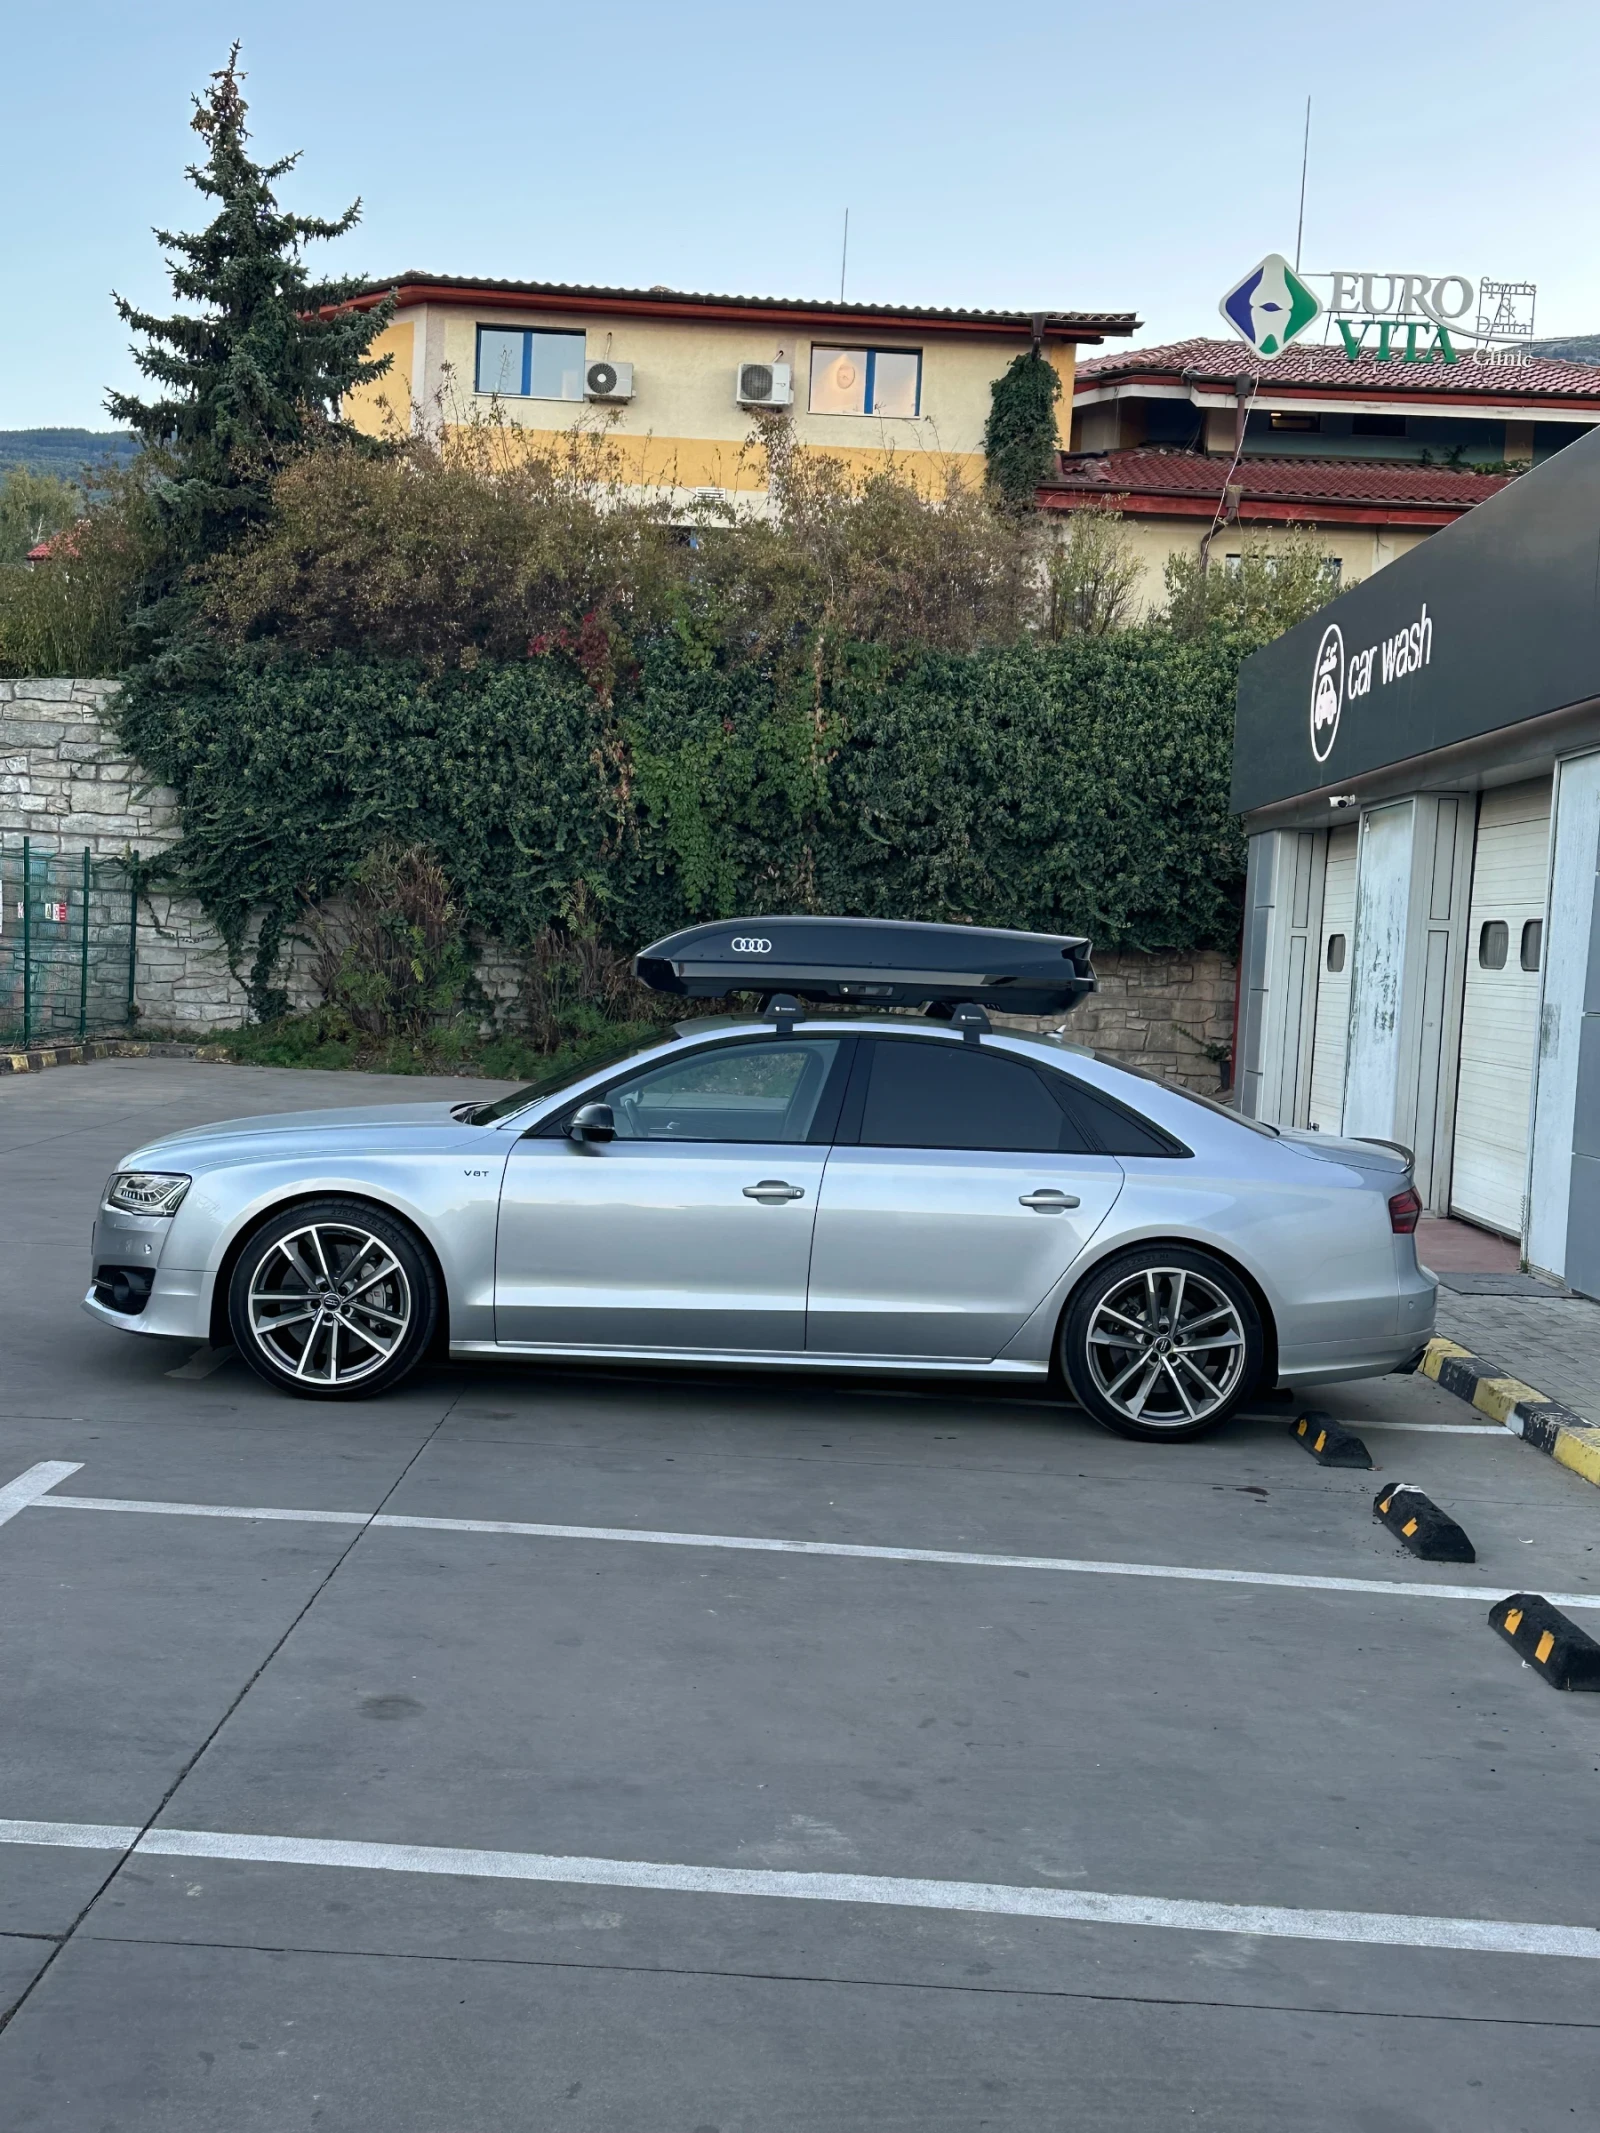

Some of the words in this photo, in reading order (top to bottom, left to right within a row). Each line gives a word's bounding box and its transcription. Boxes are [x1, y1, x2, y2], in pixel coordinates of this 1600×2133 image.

[1328, 271, 1474, 319] EURO
[1334, 319, 1459, 363] VITA
[1472, 347, 1534, 368] Clinic
[1348, 645, 1378, 700] car
[1382, 602, 1433, 685] wash
[463, 1169, 490, 1177] V8T
